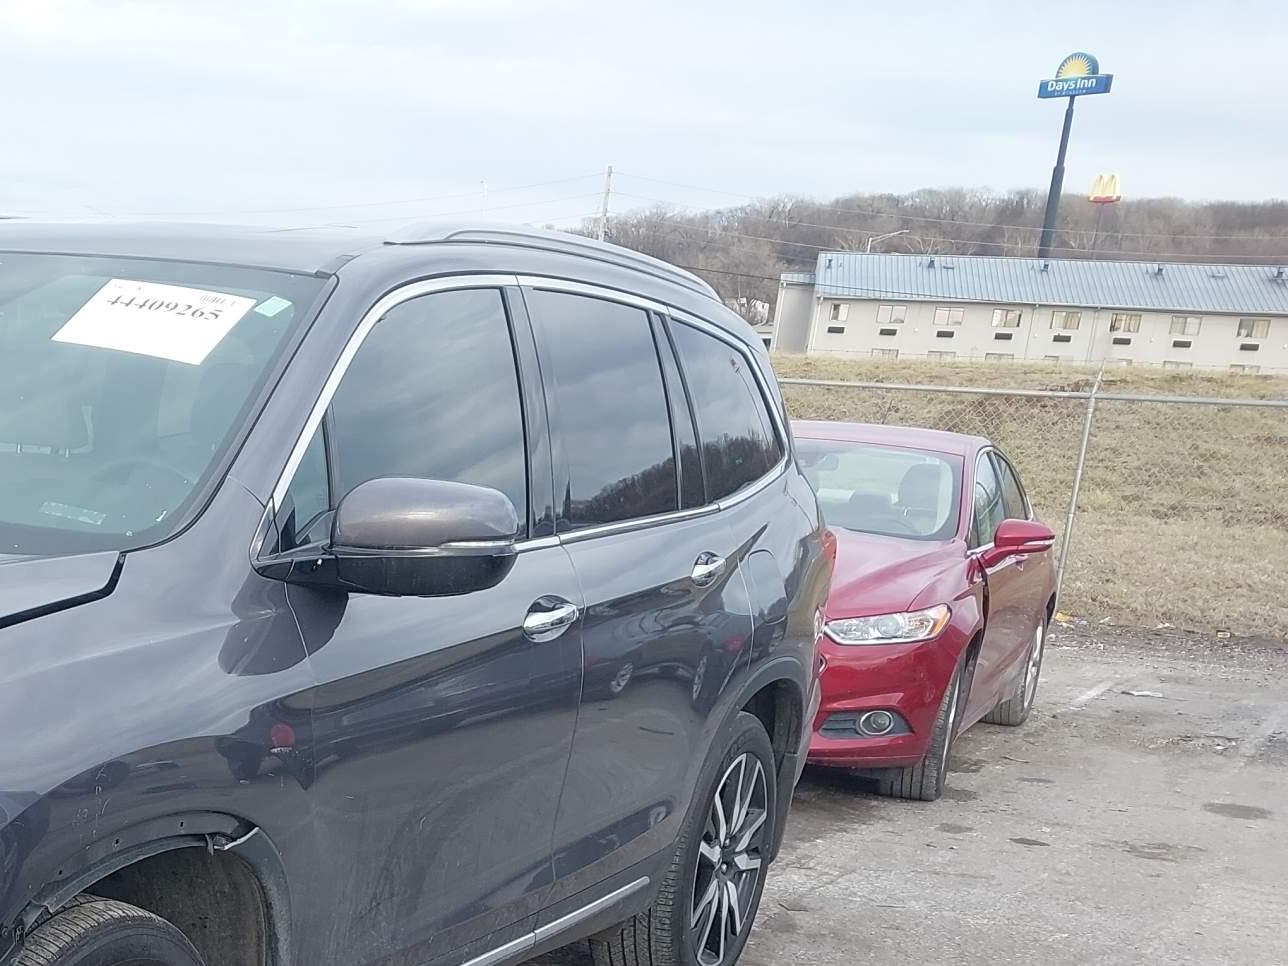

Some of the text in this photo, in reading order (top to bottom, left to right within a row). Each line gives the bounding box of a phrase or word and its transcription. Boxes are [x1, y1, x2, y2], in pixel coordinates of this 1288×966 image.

[1047, 78, 1097, 91] Days Inn
[106, 295, 224, 321] 44409265
